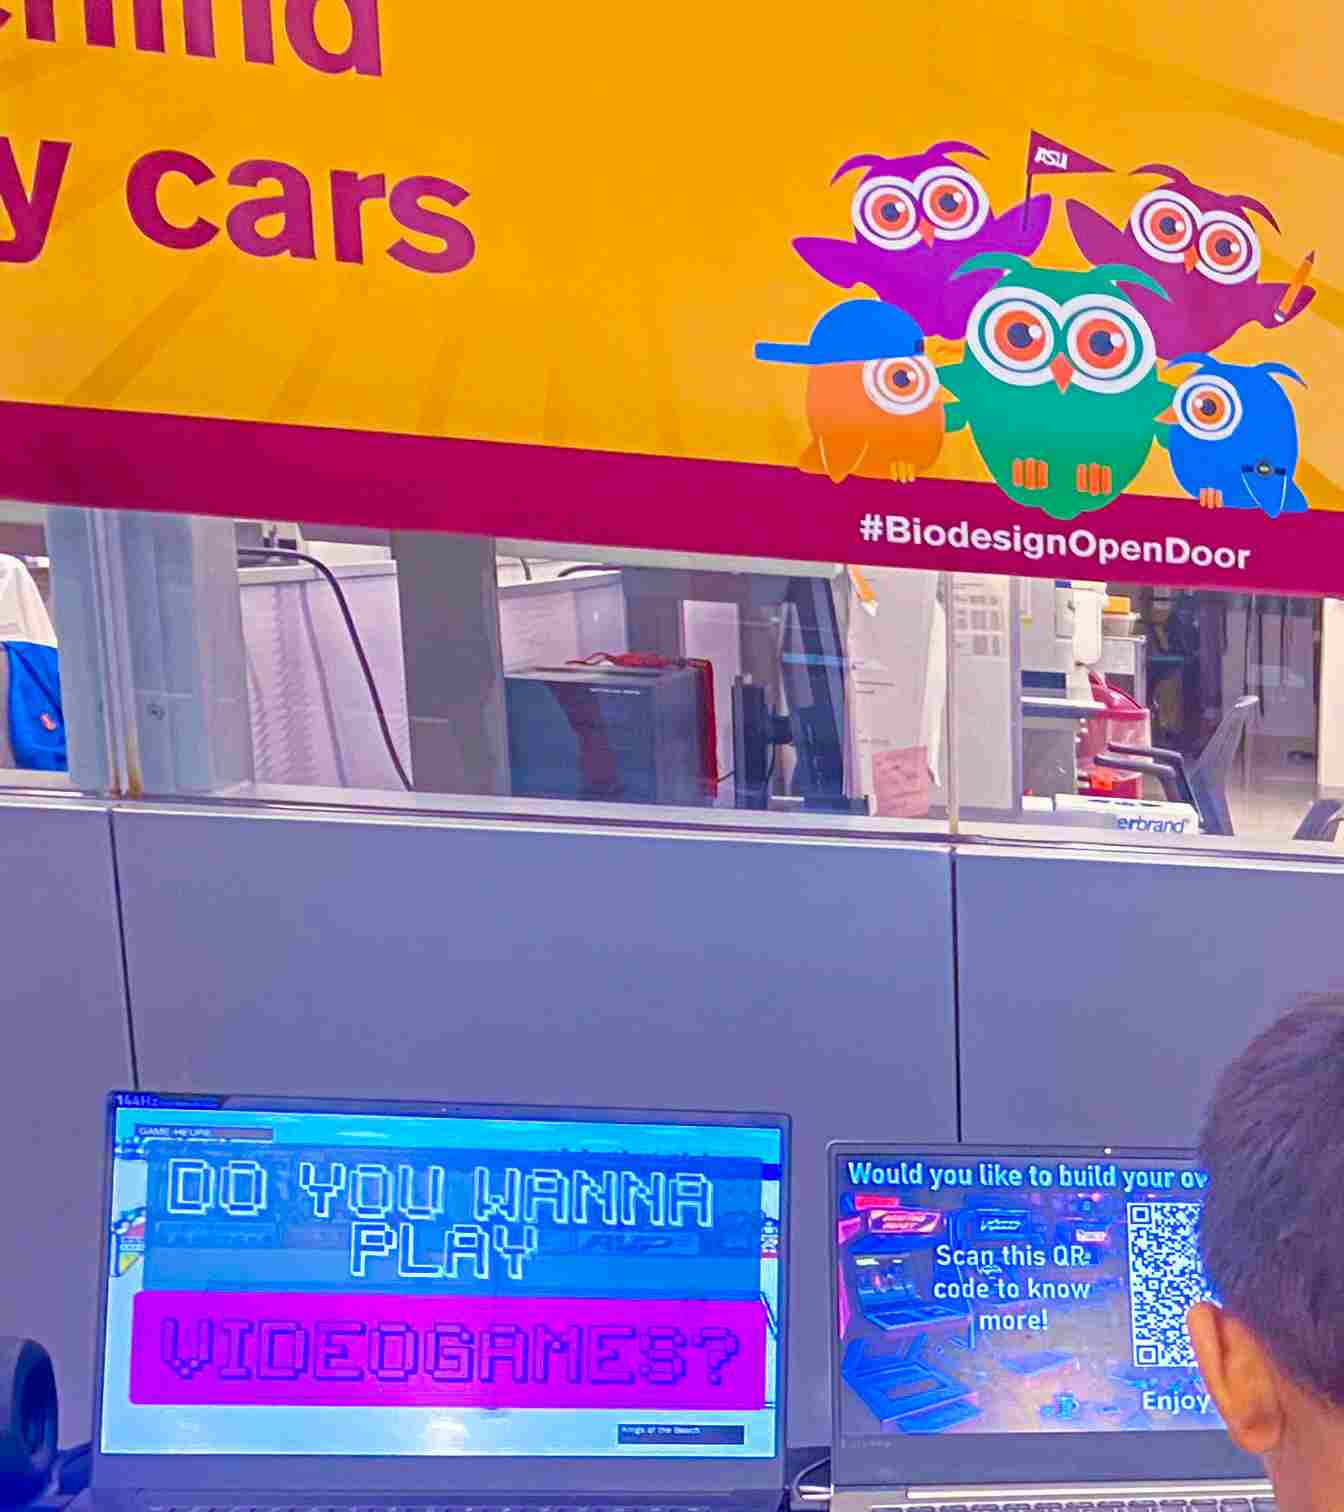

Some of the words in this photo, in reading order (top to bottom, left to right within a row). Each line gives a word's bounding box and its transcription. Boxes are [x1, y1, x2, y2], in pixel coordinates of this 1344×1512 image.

[1034, 146, 1068, 170] ASU
[125, 149, 477, 275] cars
[859, 512, 1252, 571] #BiodesignOpenDoor
[848, 1161, 923, 1185] Would
[929, 1168, 973, 1191] you
[979, 1163, 1023, 1187] like
[1028, 1165, 1052, 1187] to
[1059, 1165, 1117, 1188] build
[1122, 1170, 1175, 1192] your
[166, 1157, 267, 1216] DO
[299, 1160, 446, 1222] YOU
[474, 1164, 714, 1229] WANNA
[349, 1223, 538, 1280] PLAY
[936, 1244, 994, 1266] Scan
[1000, 1244, 1046, 1266] this
[1053, 1245, 1087, 1266] QR
[933, 1277, 990, 1299] code
[998, 1279, 1019, 1299] to
[1027, 1277, 1091, 1299] know
[979, 1308, 1048, 1330] more!
[160, 1318, 740, 1388] VIDEOGAMES?
[1142, 1390, 1212, 1415] Enjoy
